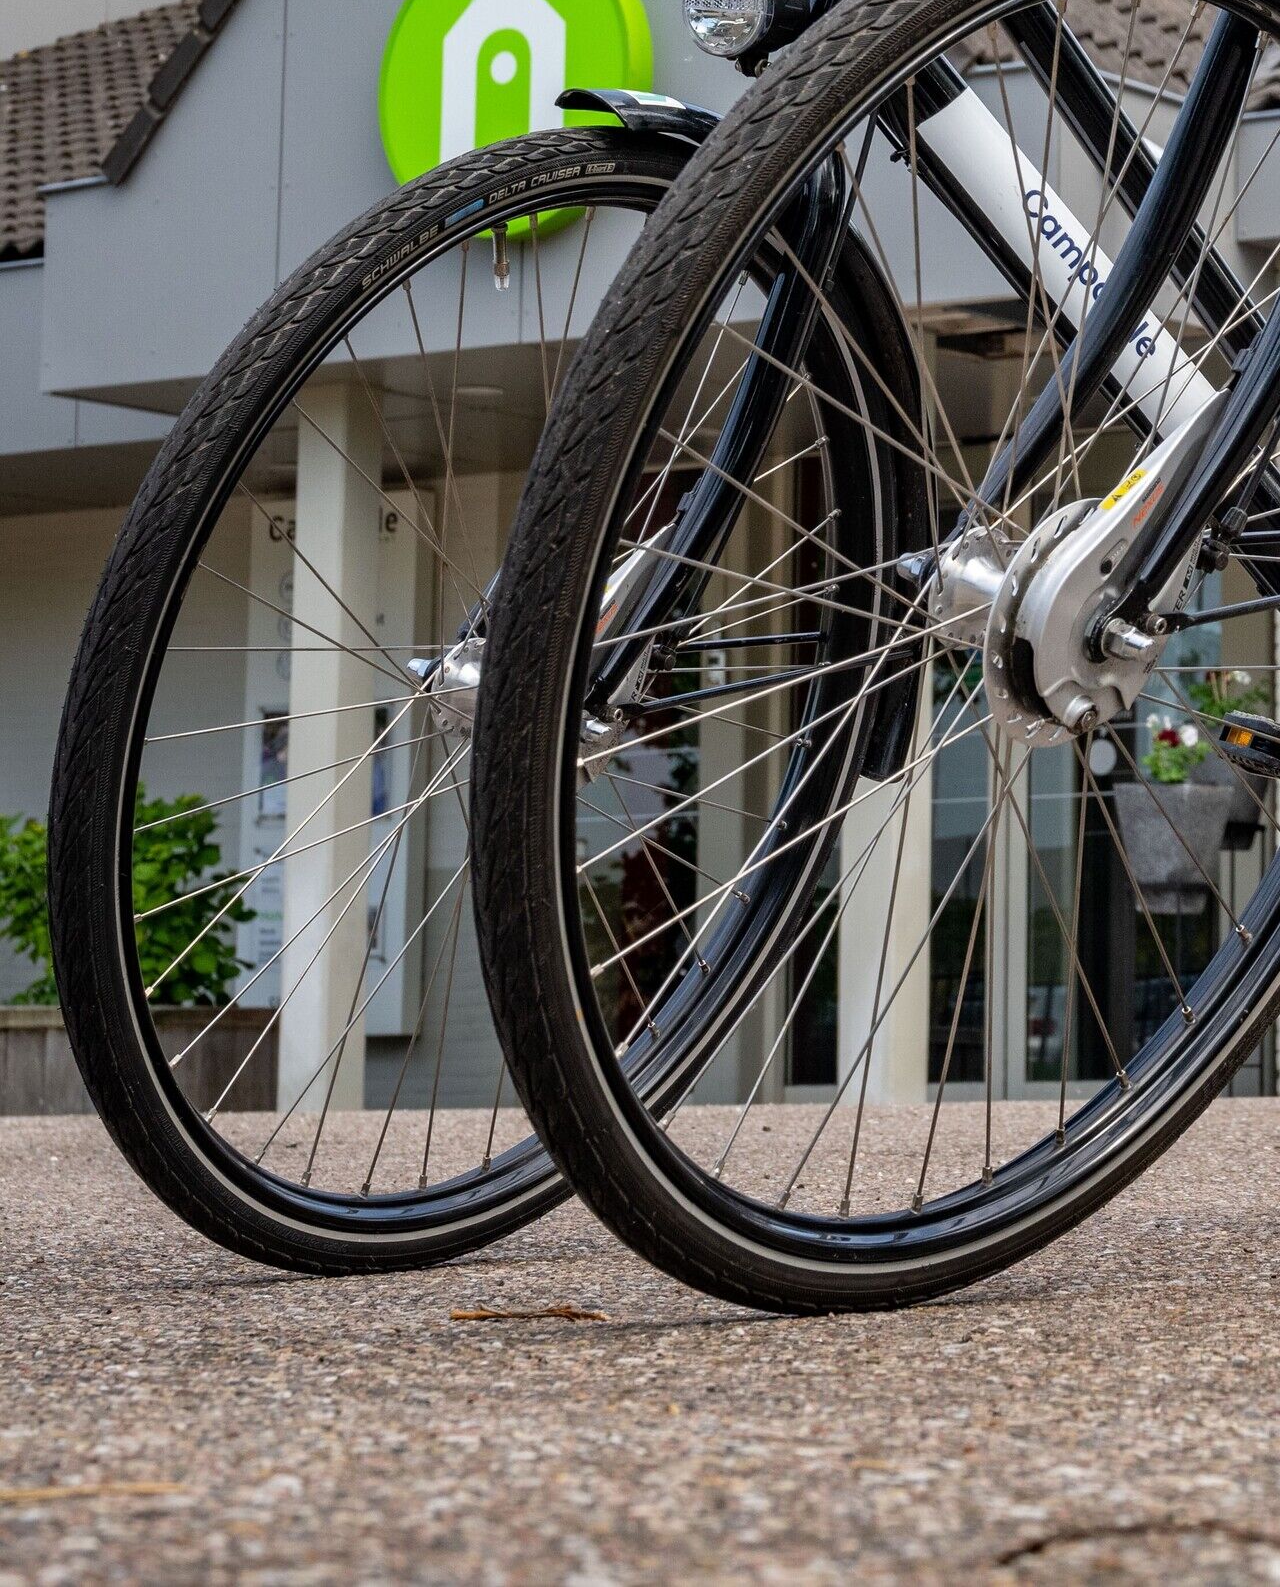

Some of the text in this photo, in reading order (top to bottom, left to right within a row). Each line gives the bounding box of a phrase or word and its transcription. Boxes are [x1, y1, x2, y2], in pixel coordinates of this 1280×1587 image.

[488, 166, 581, 204] DELTA CRUISER
[361, 225, 439, 291] SCHWALBE
